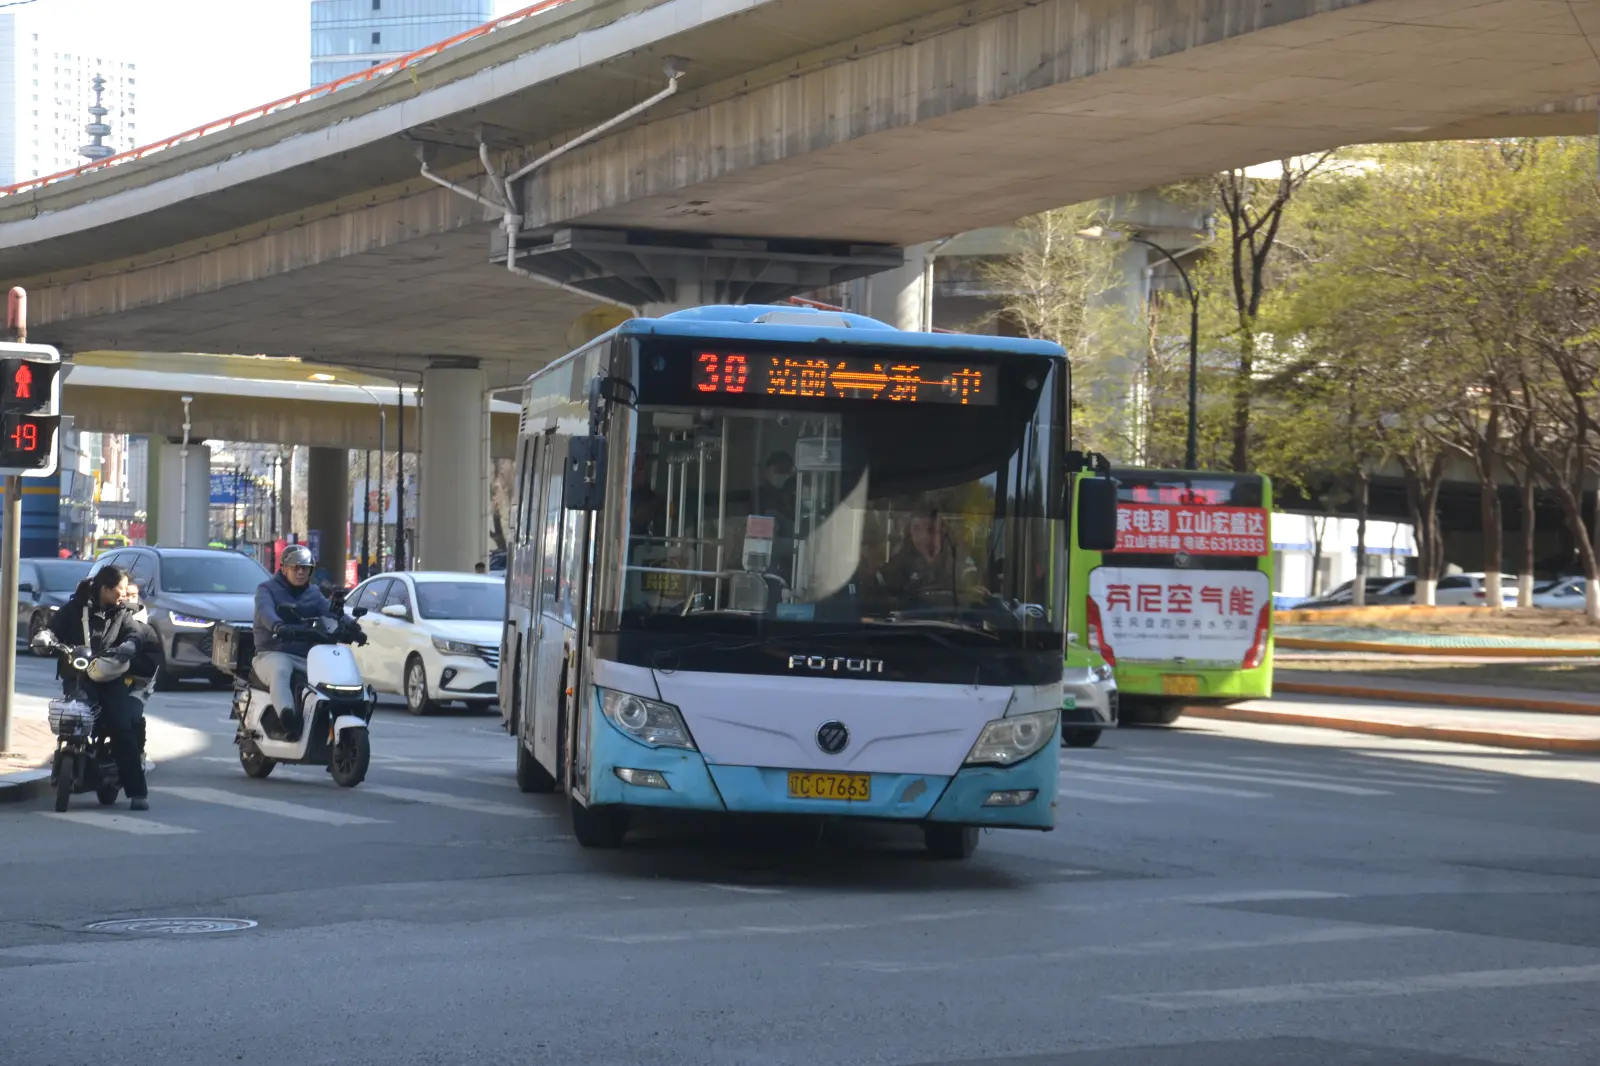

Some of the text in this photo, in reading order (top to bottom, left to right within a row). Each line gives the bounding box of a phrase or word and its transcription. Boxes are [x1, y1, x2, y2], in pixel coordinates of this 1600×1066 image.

[698, 354, 747, 392] 30
[10, 424, 37, 450] 19
[1176, 510, 1264, 536] 立山宏盛达
[1106, 584, 1254, 616] 芬尼空气能
[788, 655, 883, 672] FOTON
